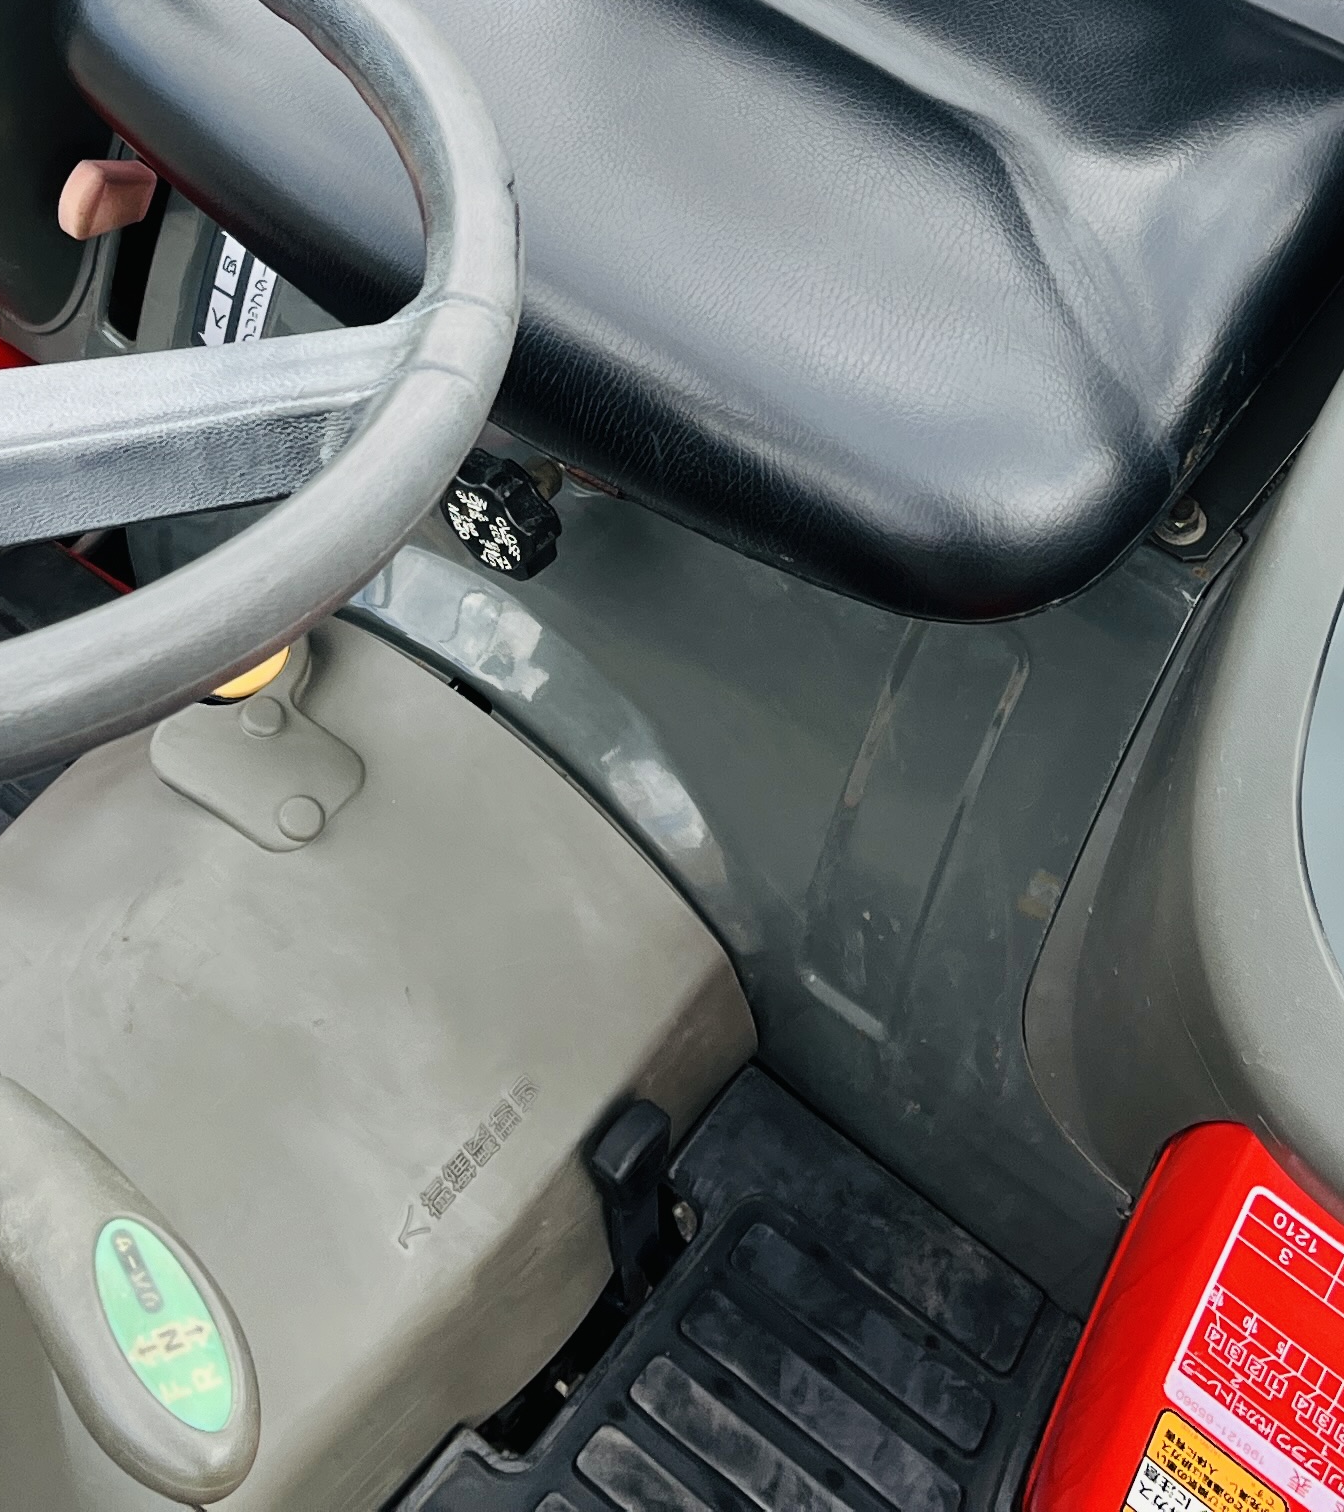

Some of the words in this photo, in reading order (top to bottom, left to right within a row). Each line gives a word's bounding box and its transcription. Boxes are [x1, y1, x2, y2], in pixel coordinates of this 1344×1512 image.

[1273, 1211, 1318, 1255] 1210
[1278, 1247, 1294, 1266] 3
[1243, 1315, 1258, 1335] 10
[1209, 1330, 1221, 1342] 4
[1229, 1344, 1242, 1360] 3
[1276, 1341, 1286, 1355] 5
[1249, 1360, 1262, 1374] 2
[190, 1364, 223, 1392] R
[1182, 1359, 1234, 1405] トレーラ
[1231, 1373, 1244, 1388] 2
[1269, 1375, 1281, 1390] 1
[1296, 1396, 1308, 1409] 4
[1175, 1389, 1266, 1467] 198121-65560
[1236, 1400, 1274, 1437] 代カキ
[1318, 1413, 1331, 1428] 3
[1144, 1461, 1191, 1510] に注意
[1287, 1467, 1313, 1498] 表
